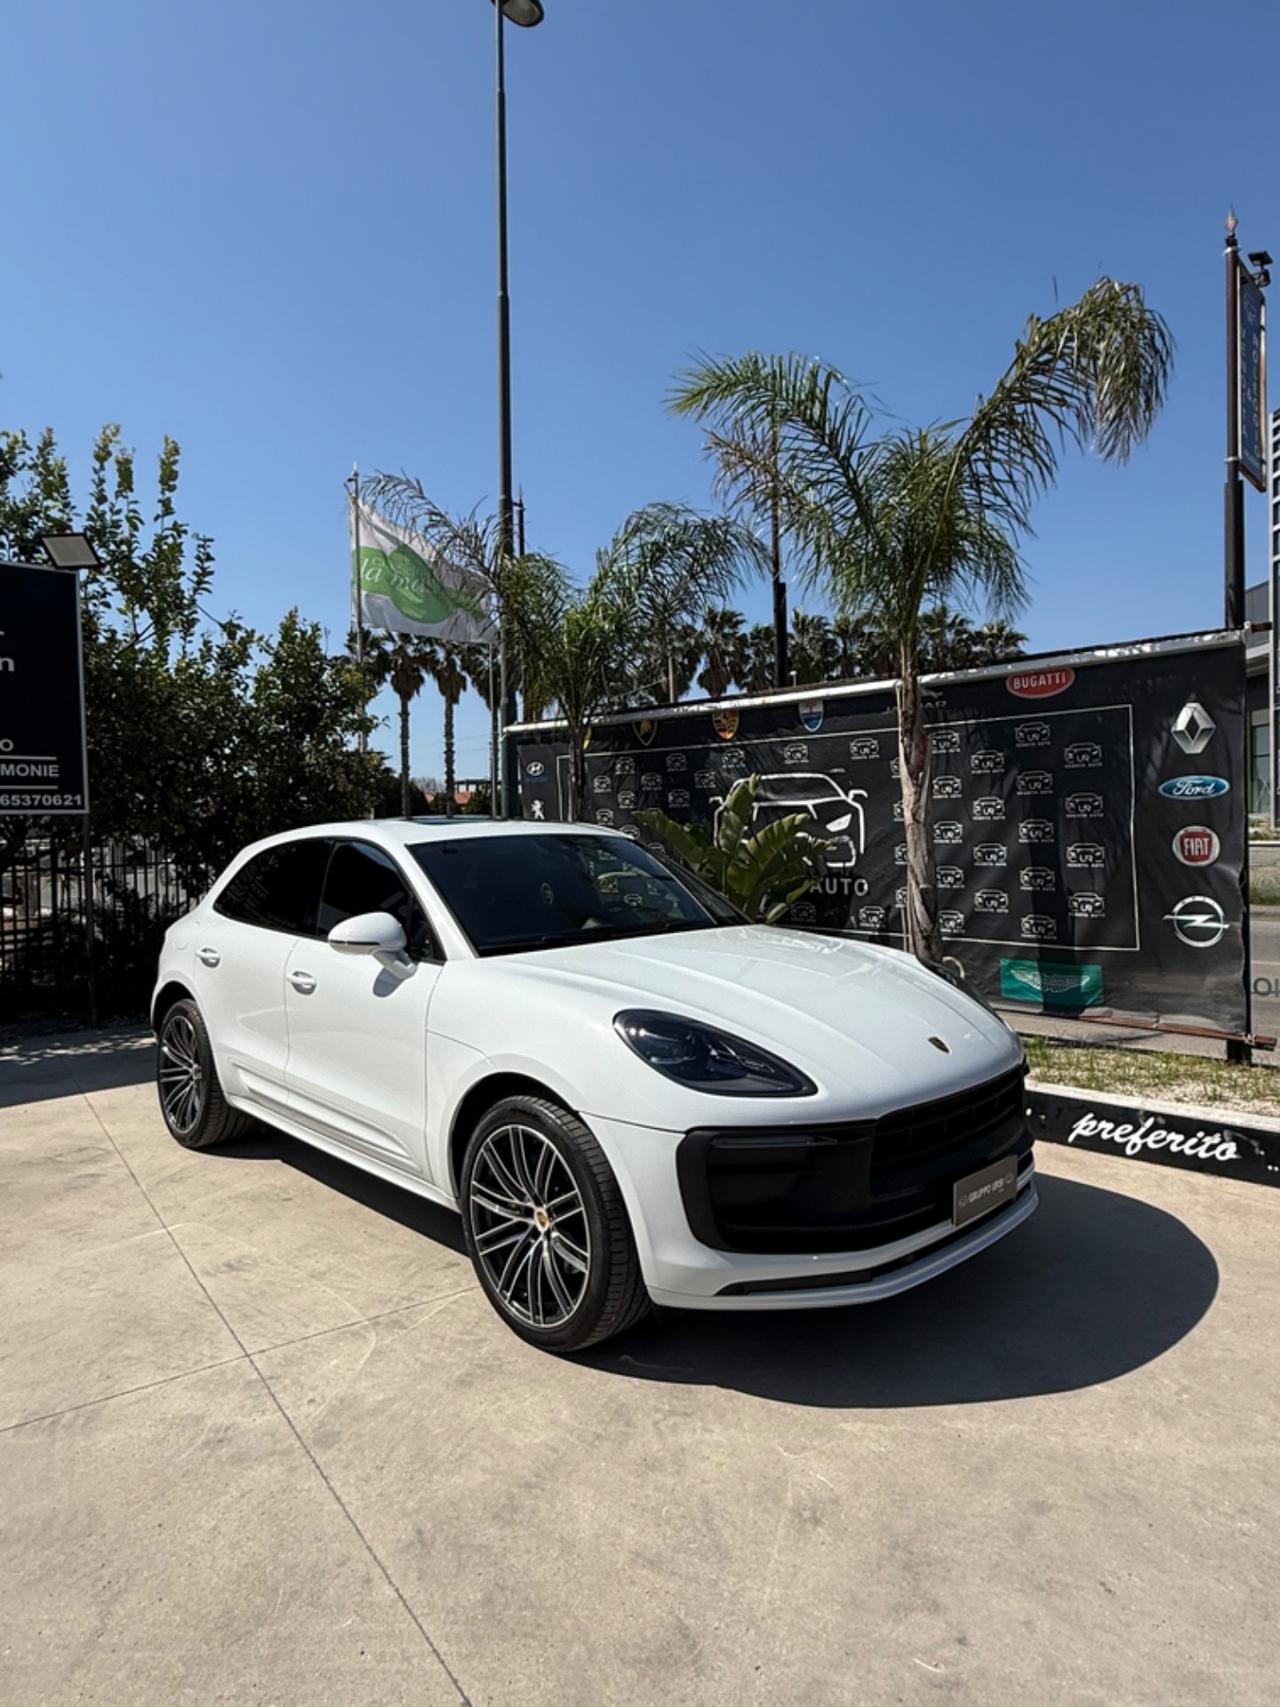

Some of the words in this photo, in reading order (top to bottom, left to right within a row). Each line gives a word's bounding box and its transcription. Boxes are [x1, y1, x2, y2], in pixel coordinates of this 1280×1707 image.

[1013, 672, 1066, 689] BUGATTI
[1172, 779, 1216, 796] Ford
[0, 793, 82, 806] 65370621
[1183, 837, 1210, 856] FIAT
[810, 877, 869, 897] AUTO
[1067, 1112, 1242, 1161] preferito
